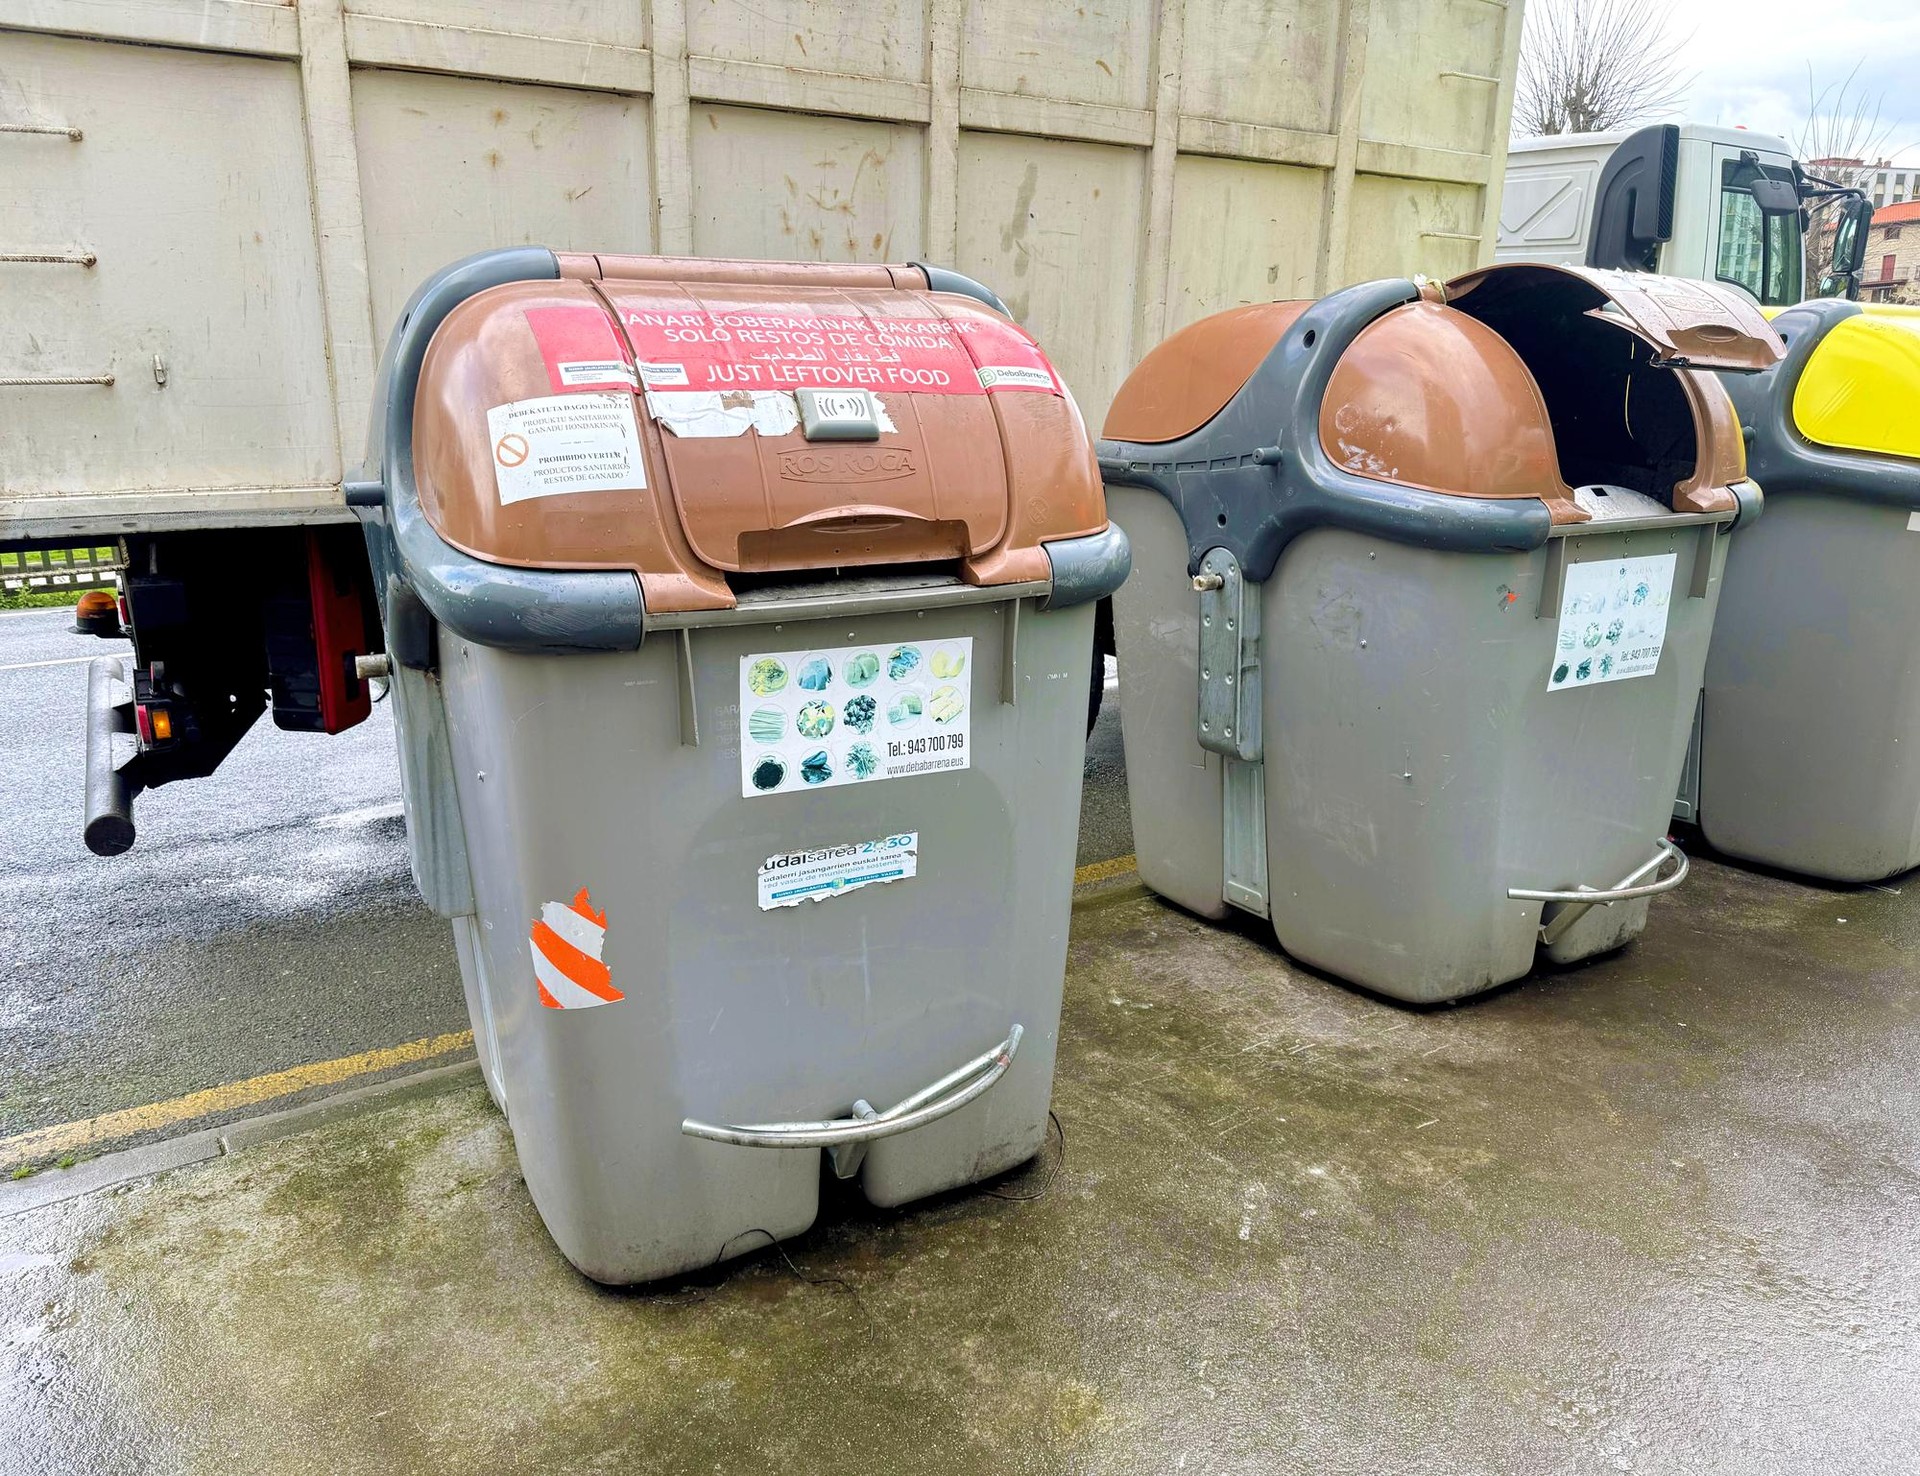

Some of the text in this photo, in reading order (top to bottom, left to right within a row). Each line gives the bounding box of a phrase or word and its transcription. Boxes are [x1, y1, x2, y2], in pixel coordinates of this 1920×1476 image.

[711, 315, 872, 331] SOBERAKINAK
[664, 328, 954, 350] SOLO RESTOS DE COMIDA
[707, 364, 950, 386] JUST LEFTOVER FOOD
[508, 405, 563, 419] DEBEKATUTA
[564, 403, 589, 411] DAGO
[522, 413, 623, 428] PRODUKTU SANITARIOAK
[528, 421, 620, 435] GANADU HONDAKINAK
[538, 451, 622, 464] PROHIBIDO VERTER
[533, 462, 631, 477] PRODUCTOS SANITARIOS
[543, 472, 624, 485] RESTOS DE GANADO
[887, 733, 964, 757] Tel.: 943 700 799
[886, 757, 964, 775] www.debabarrena.eus
[861, 835, 912, 853] 230
[763, 853, 902, 883] udalerri jasangarrien euskal sarea
[780, 877, 804, 886] vasca
[805, 873, 817, 882] de
[818, 866, 865, 880] municipios
